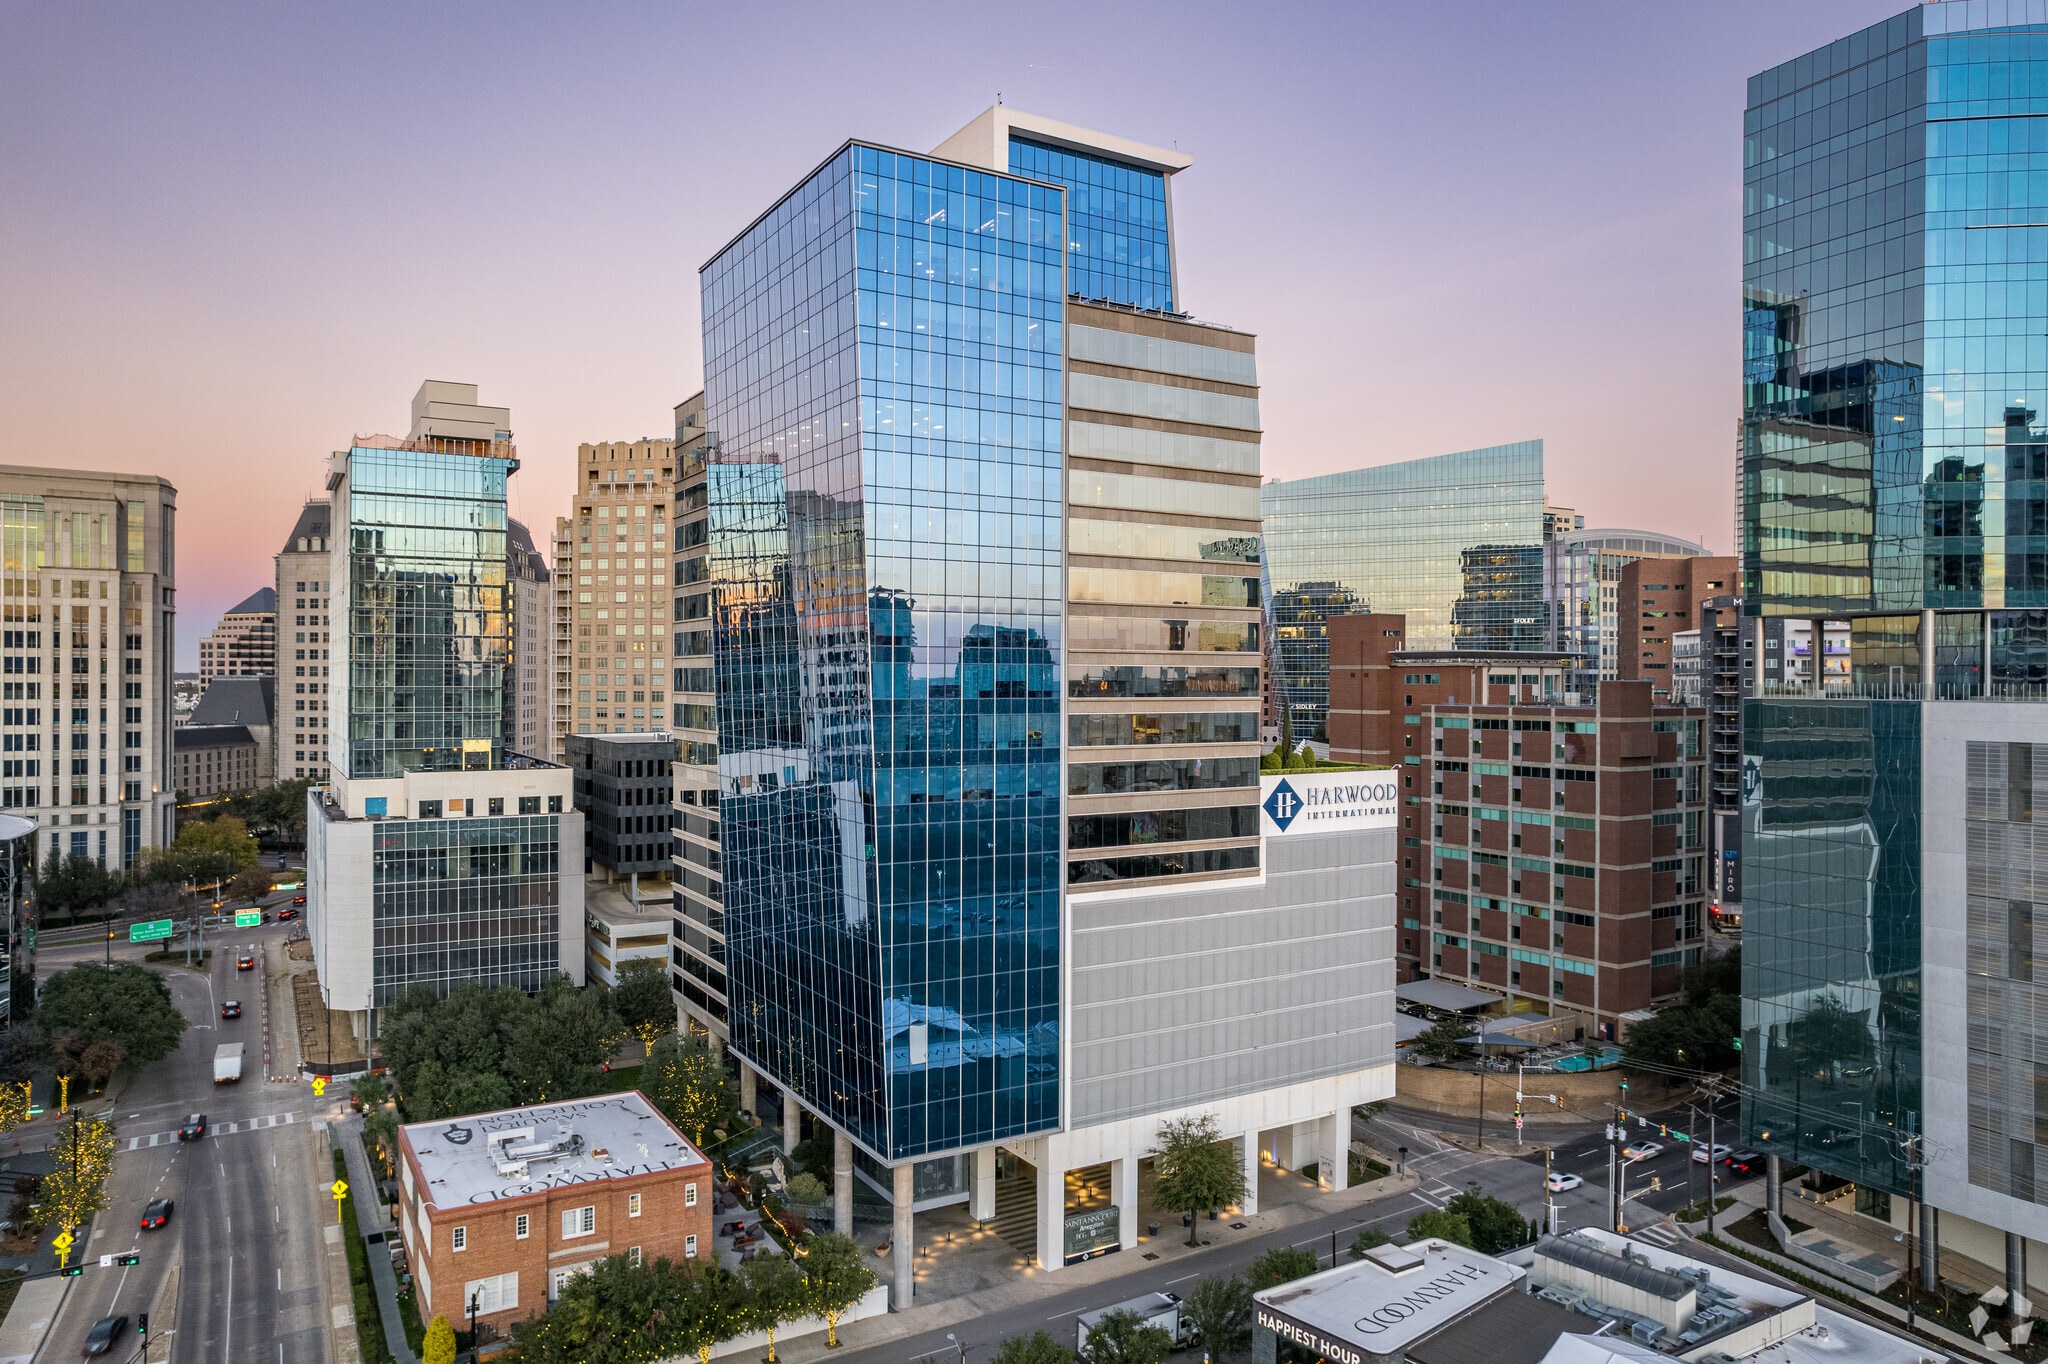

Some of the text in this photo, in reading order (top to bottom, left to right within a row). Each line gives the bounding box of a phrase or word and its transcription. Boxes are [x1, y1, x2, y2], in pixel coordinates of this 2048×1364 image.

[1307, 783, 1397, 806] HARWOOD
[1307, 806, 1397, 820] INTERNATIONAL
[477, 1099, 626, 1126] COLLECTION
[482, 1111, 587, 1133] SAMURAI
[1354, 1264, 1488, 1334] HARWOOD
[1258, 1311, 1361, 1364] HAPPIEST HOUR
